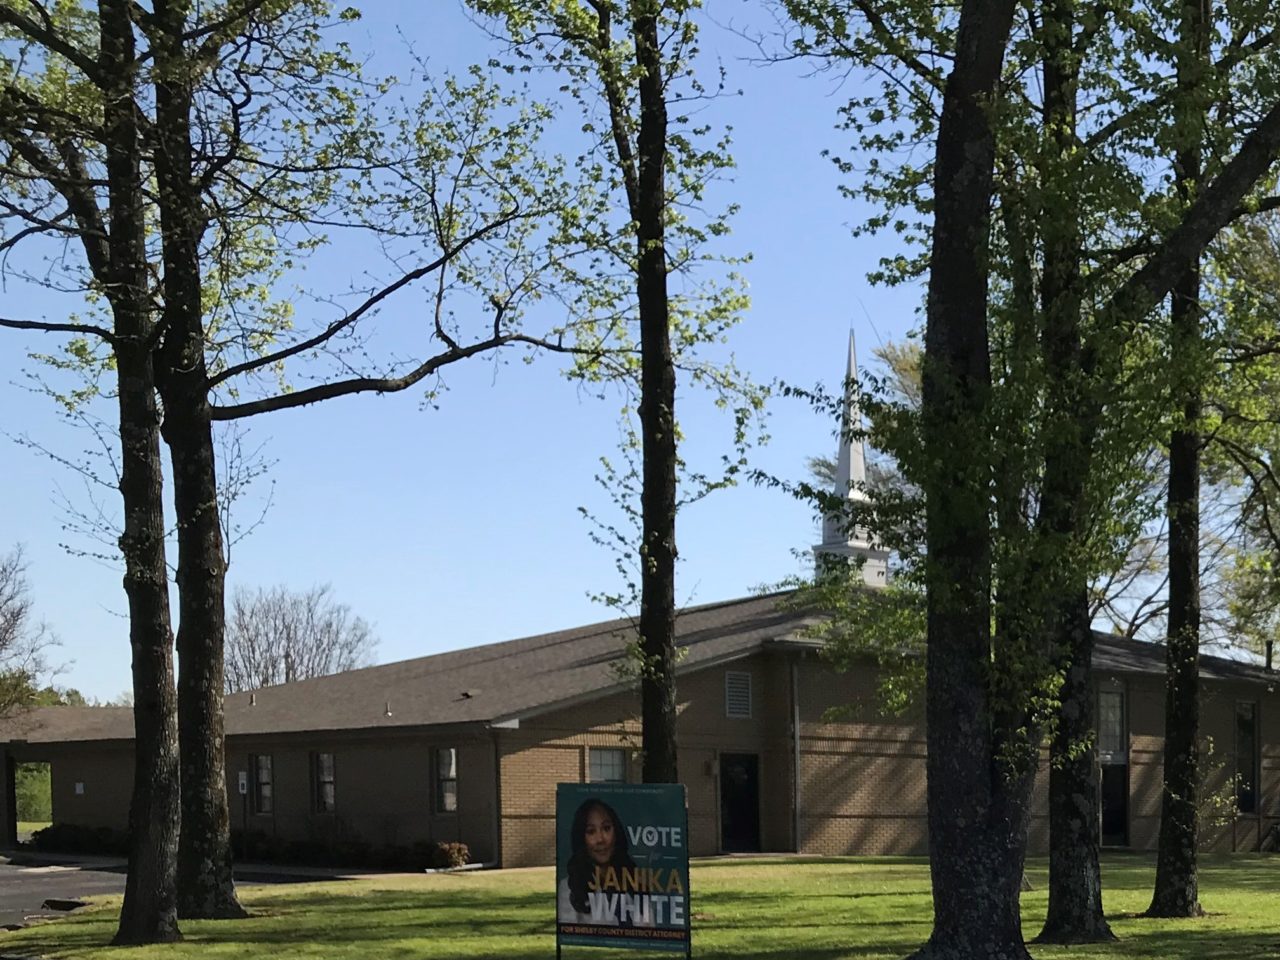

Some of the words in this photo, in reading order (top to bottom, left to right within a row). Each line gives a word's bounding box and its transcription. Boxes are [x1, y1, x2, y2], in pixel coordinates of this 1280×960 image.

[627, 826, 682, 847] VOTE
[587, 866, 684, 893] JANIKA
[587, 892, 685, 925] WHITE
